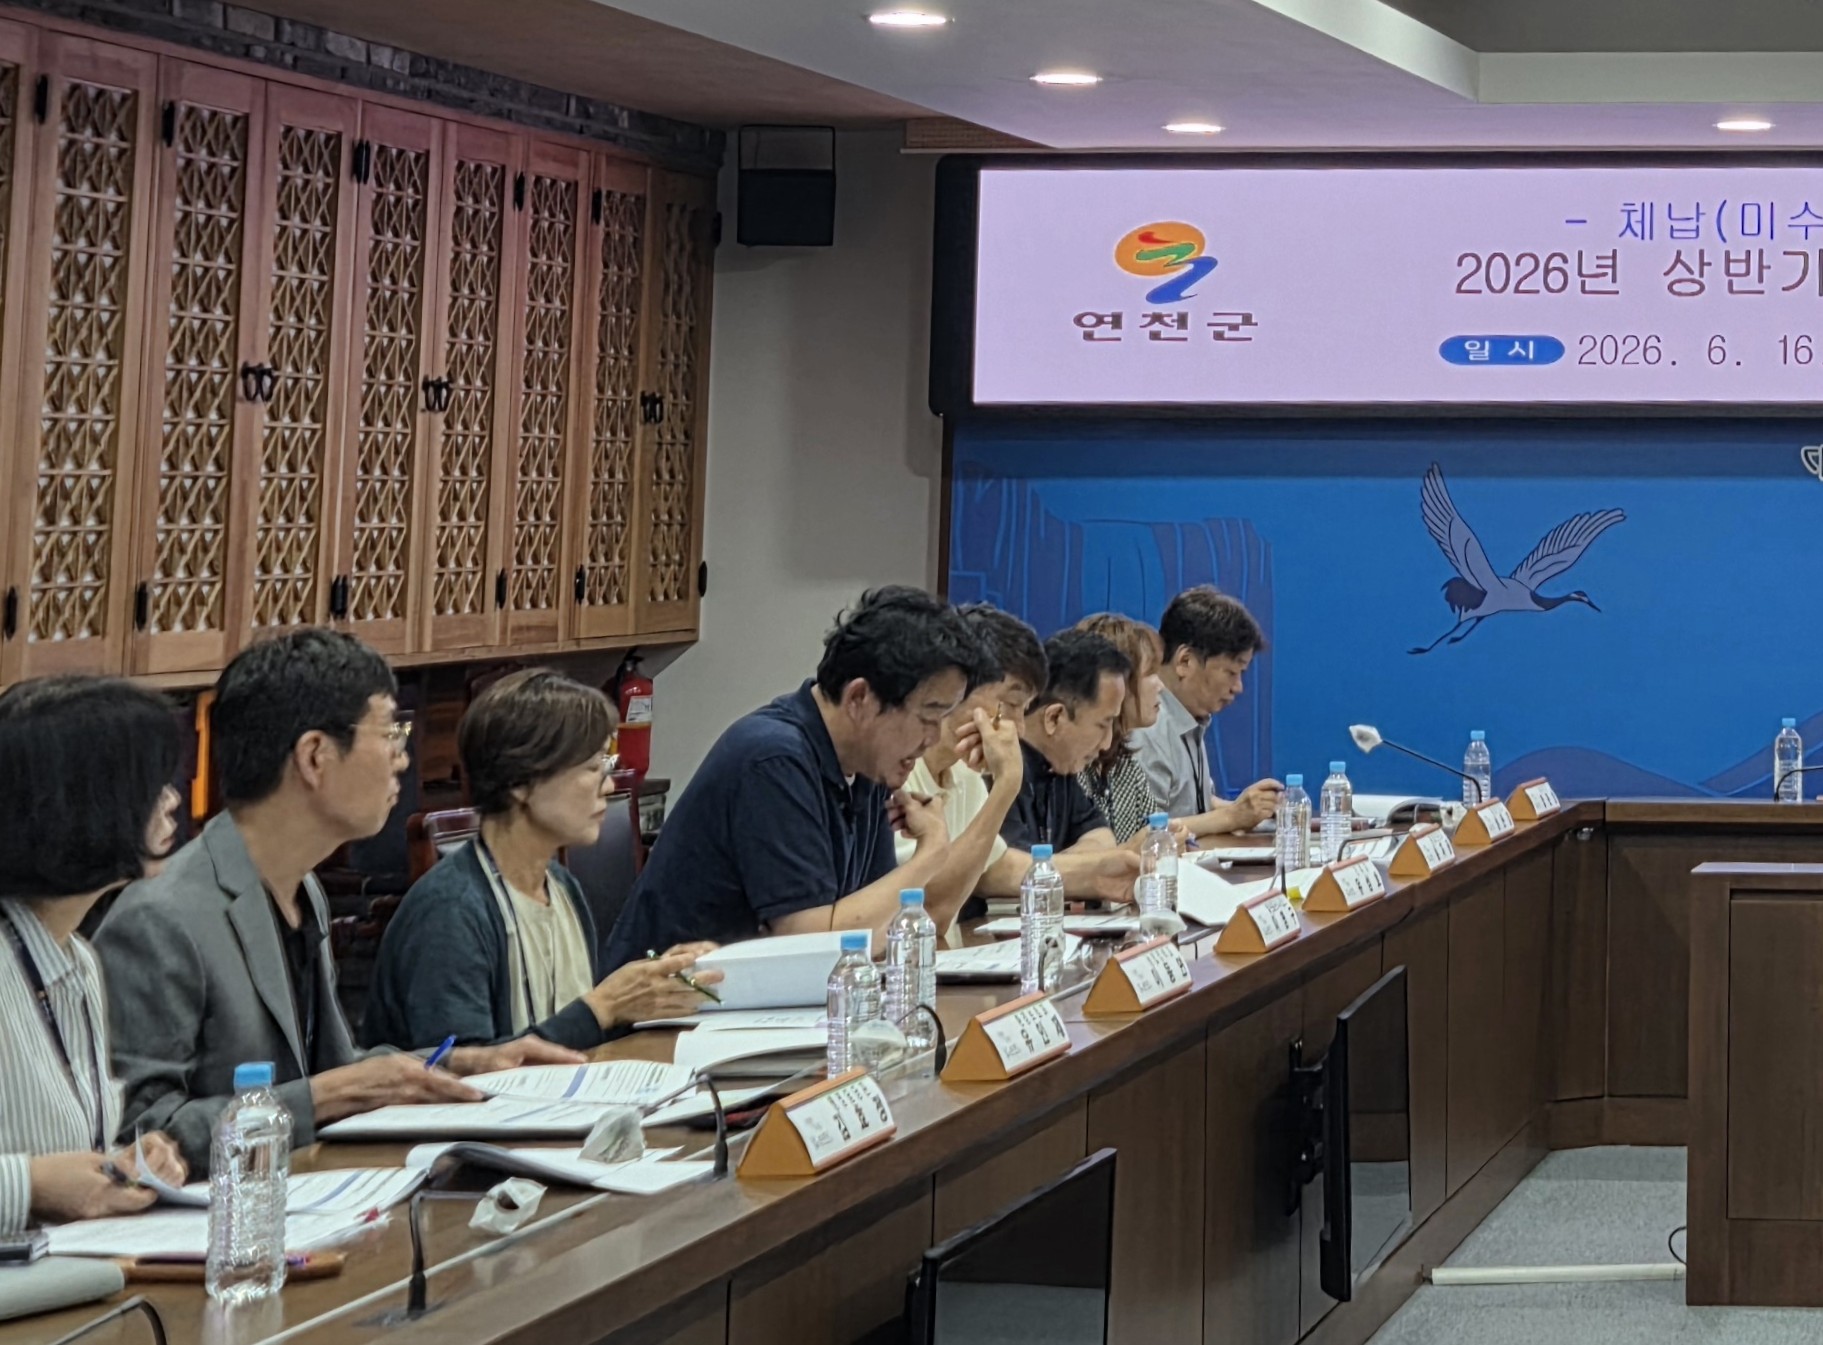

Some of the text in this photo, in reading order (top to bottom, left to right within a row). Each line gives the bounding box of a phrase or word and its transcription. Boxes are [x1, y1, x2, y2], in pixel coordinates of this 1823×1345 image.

[1455, 248, 1620, 296] 2026년
[1072, 311, 1259, 342] 연천군
[1577, 334, 1677, 367] 2026.
[1707, 334, 1742, 367] 6.
